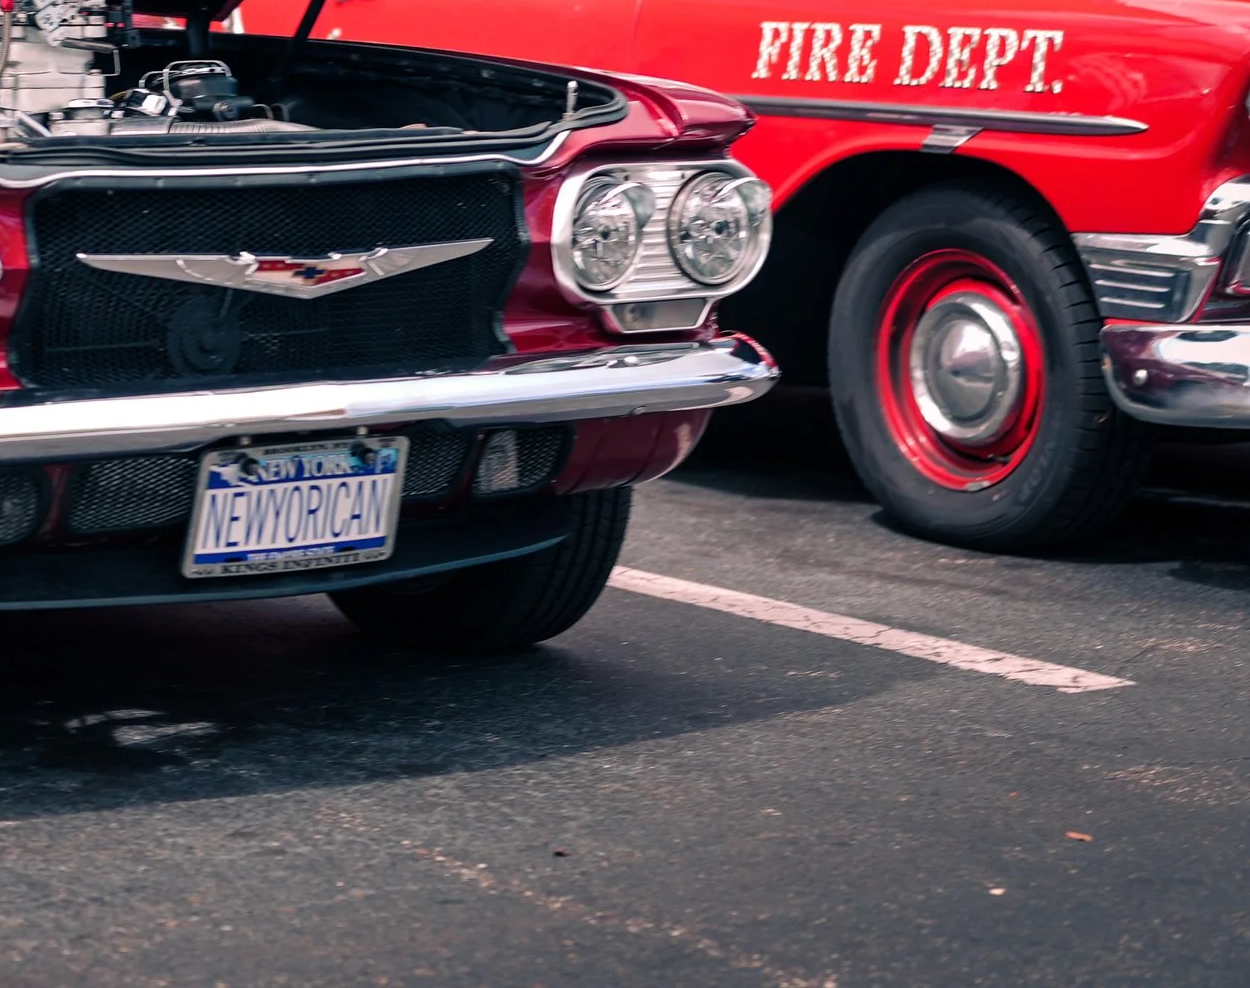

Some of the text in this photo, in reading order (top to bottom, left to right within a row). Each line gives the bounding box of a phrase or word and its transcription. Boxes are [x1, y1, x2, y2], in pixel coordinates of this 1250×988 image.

[751, 21, 1065, 94] FIRE DEPT.
[252, 454, 351, 482] NEW YORK
[201, 478, 389, 550] NEWYORICAN
[221, 560, 278, 574] KINGS
